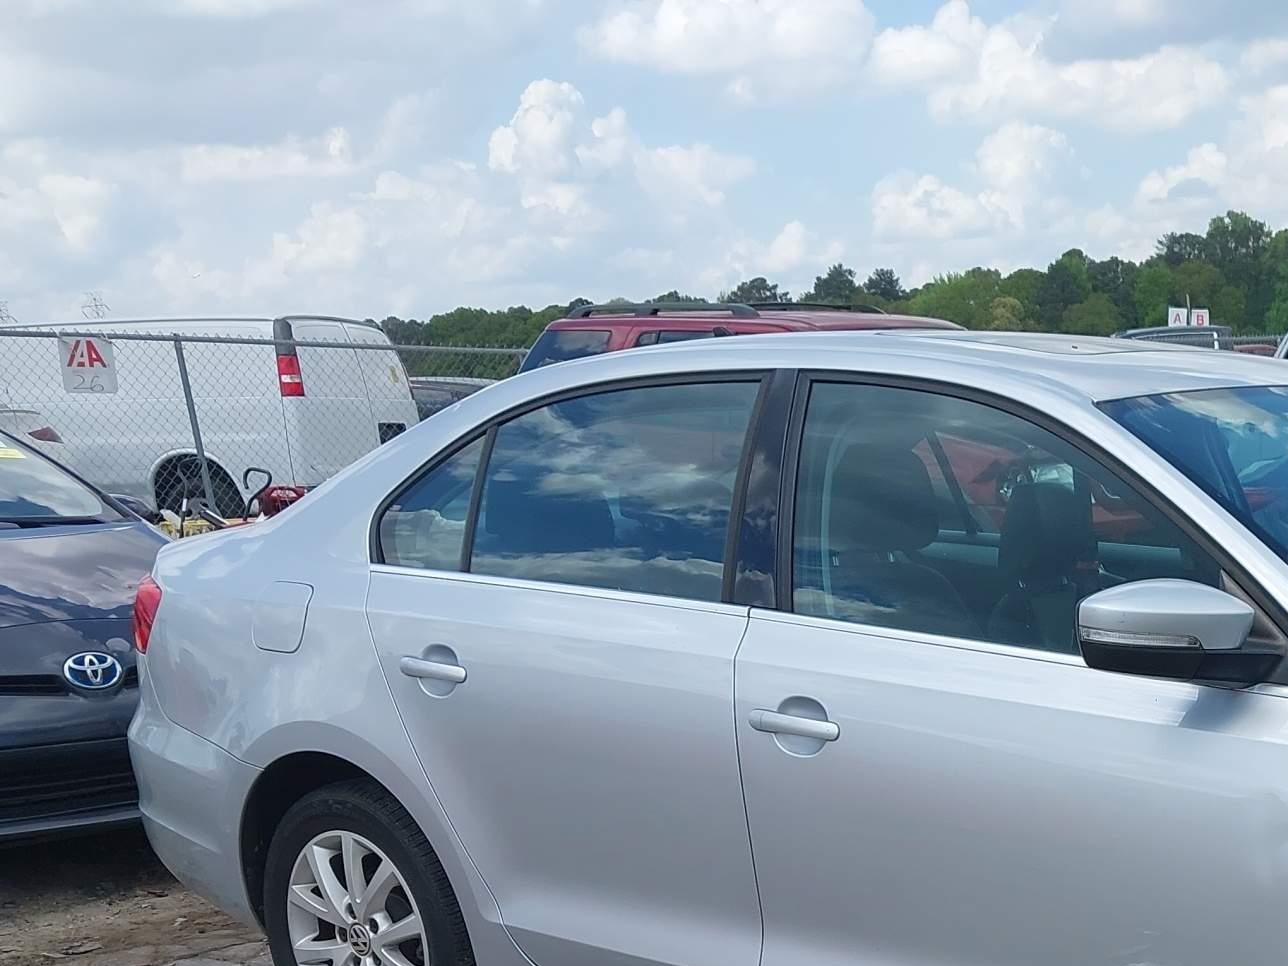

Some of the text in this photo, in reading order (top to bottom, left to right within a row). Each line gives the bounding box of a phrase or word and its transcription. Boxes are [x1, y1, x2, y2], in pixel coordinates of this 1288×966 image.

[1173, 312, 1182, 325] A
[1196, 314, 1205, 326] B
[72, 374, 105, 391] 26
